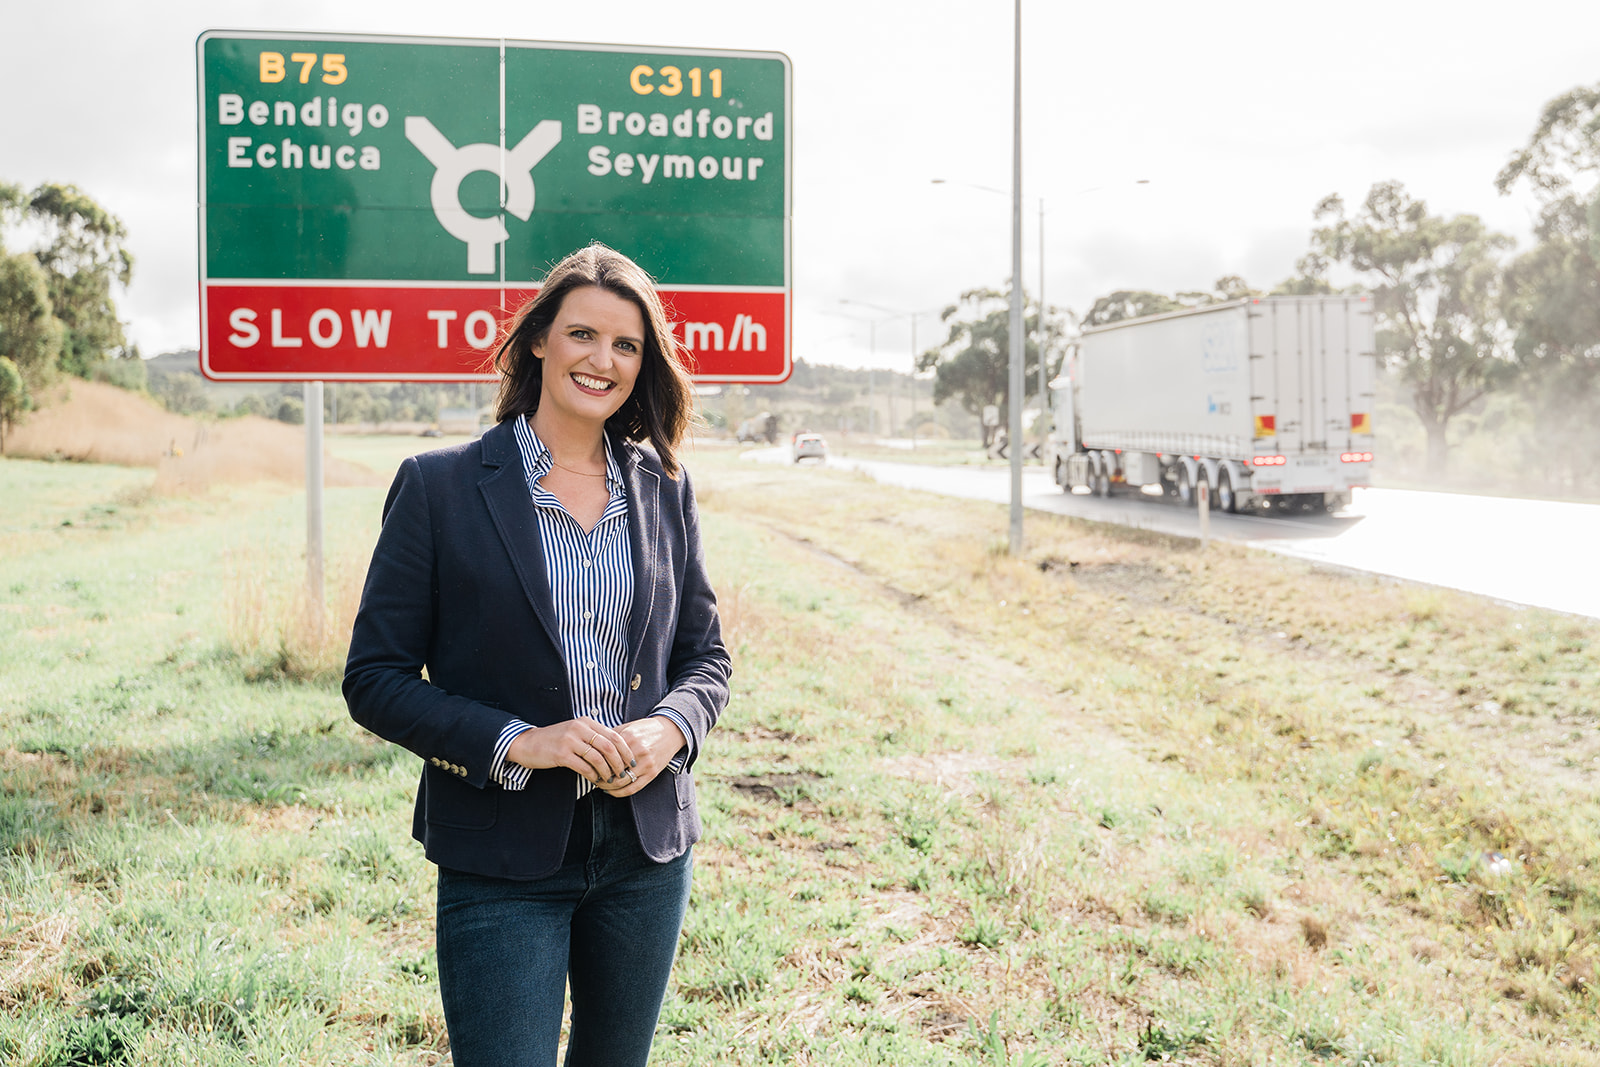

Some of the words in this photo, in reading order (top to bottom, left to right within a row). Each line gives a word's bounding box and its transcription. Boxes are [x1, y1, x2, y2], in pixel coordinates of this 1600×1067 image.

[259, 51, 349, 85] B75
[630, 64, 723, 98] C311
[218, 93, 390, 137] Bendigo
[577, 103, 774, 141] Broadford
[227, 136, 381, 170] Echuca
[587, 145, 765, 184] Seymour
[228, 308, 392, 348] SLOW
[427, 309, 497, 350] TO
